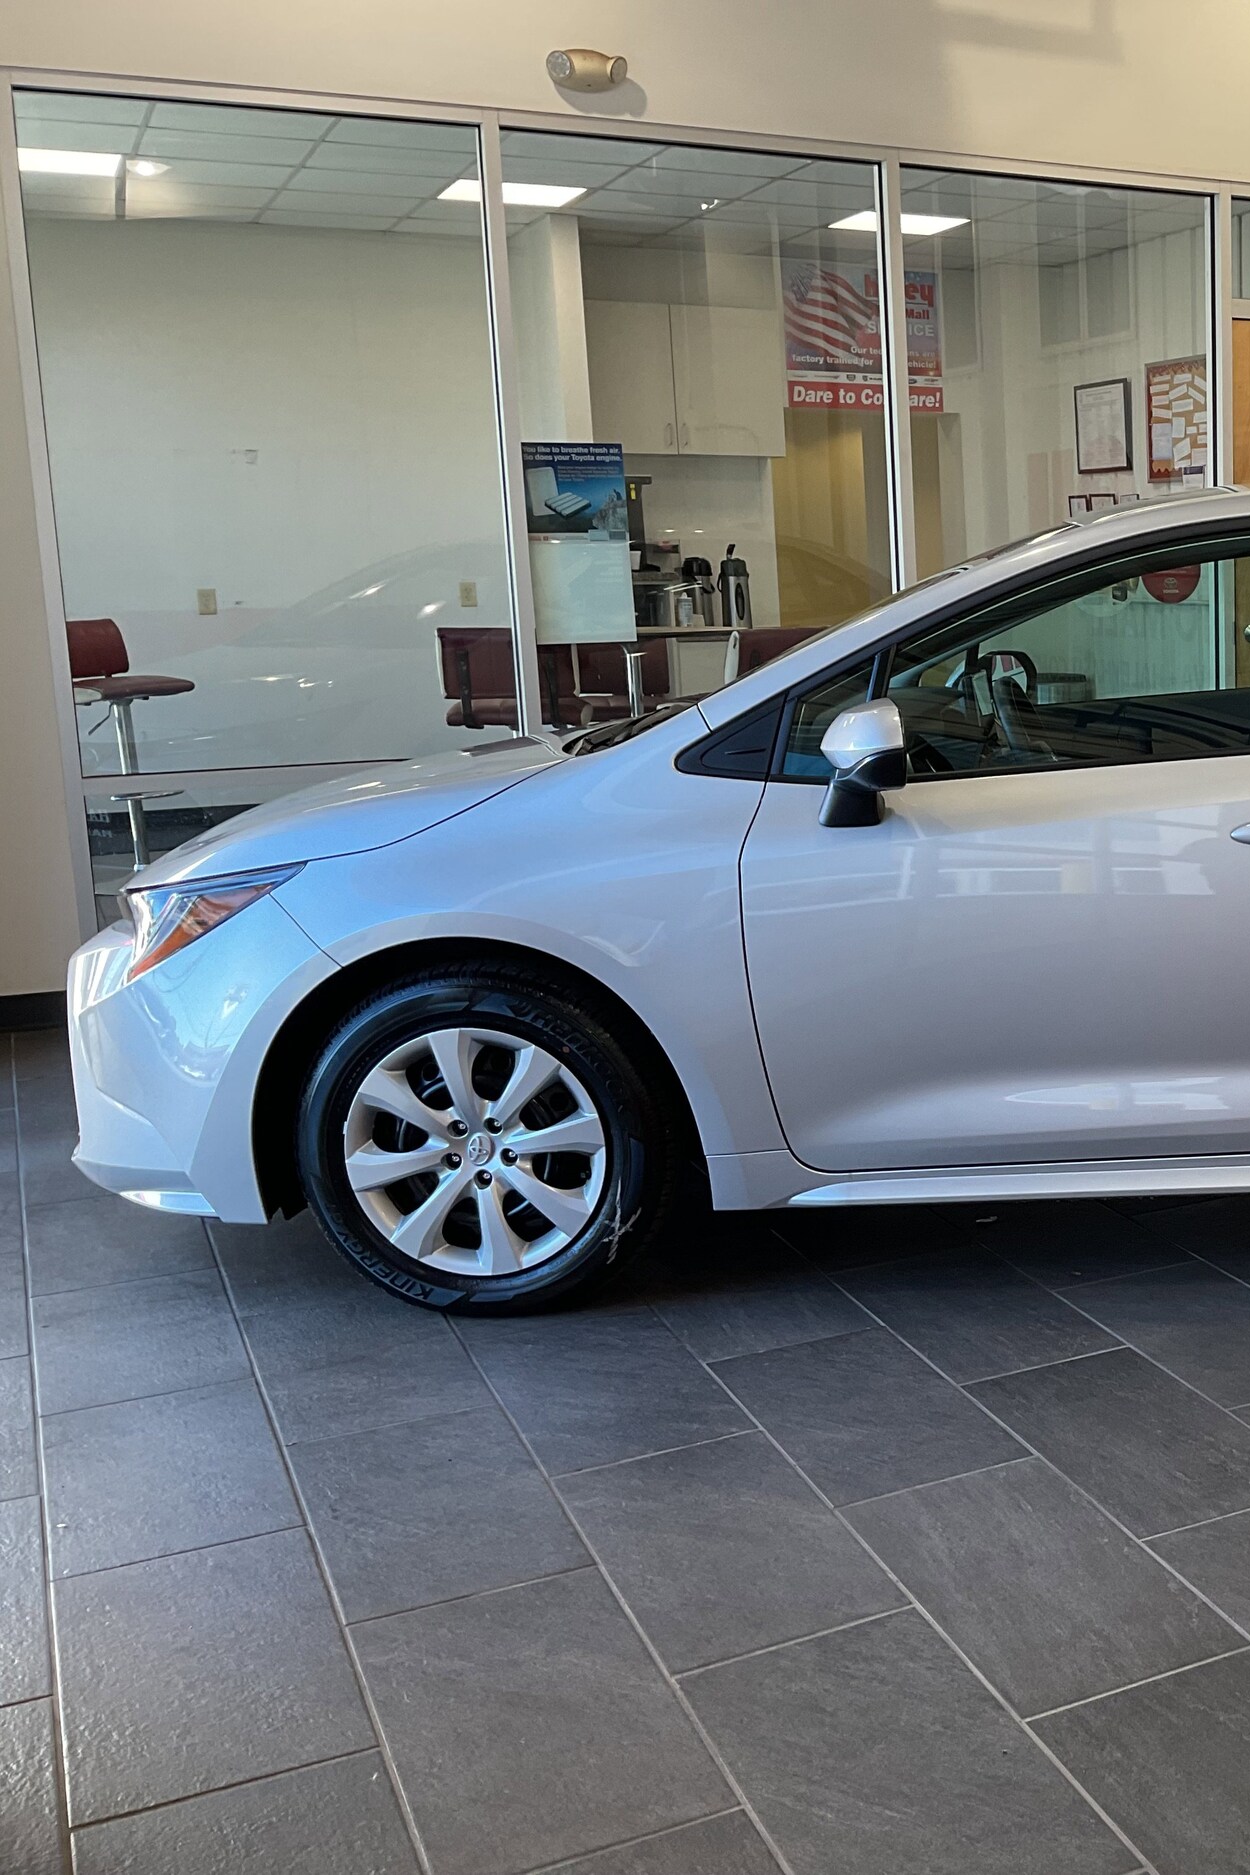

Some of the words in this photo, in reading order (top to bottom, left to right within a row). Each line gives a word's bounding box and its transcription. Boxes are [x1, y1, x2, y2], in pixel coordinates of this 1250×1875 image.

[864, 273, 934, 308] hey
[866, 321, 935, 337] SICE
[850, 346, 867, 354] Our
[792, 354, 824, 365] factory
[827, 355, 858, 365] trained
[908, 360, 937, 369] ehicle!
[793, 385, 834, 403] Dare
[839, 388, 856, 404] to
[861, 388, 941, 408] Coare!
[551, 446, 560, 454] to
[560, 446, 588, 454] breathe
[589, 446, 609, 454] fresh
[534, 453, 553, 461] does
[553, 454, 571, 462] your
[571, 453, 595, 462] Toyota
[595, 454, 623, 463] engine.
